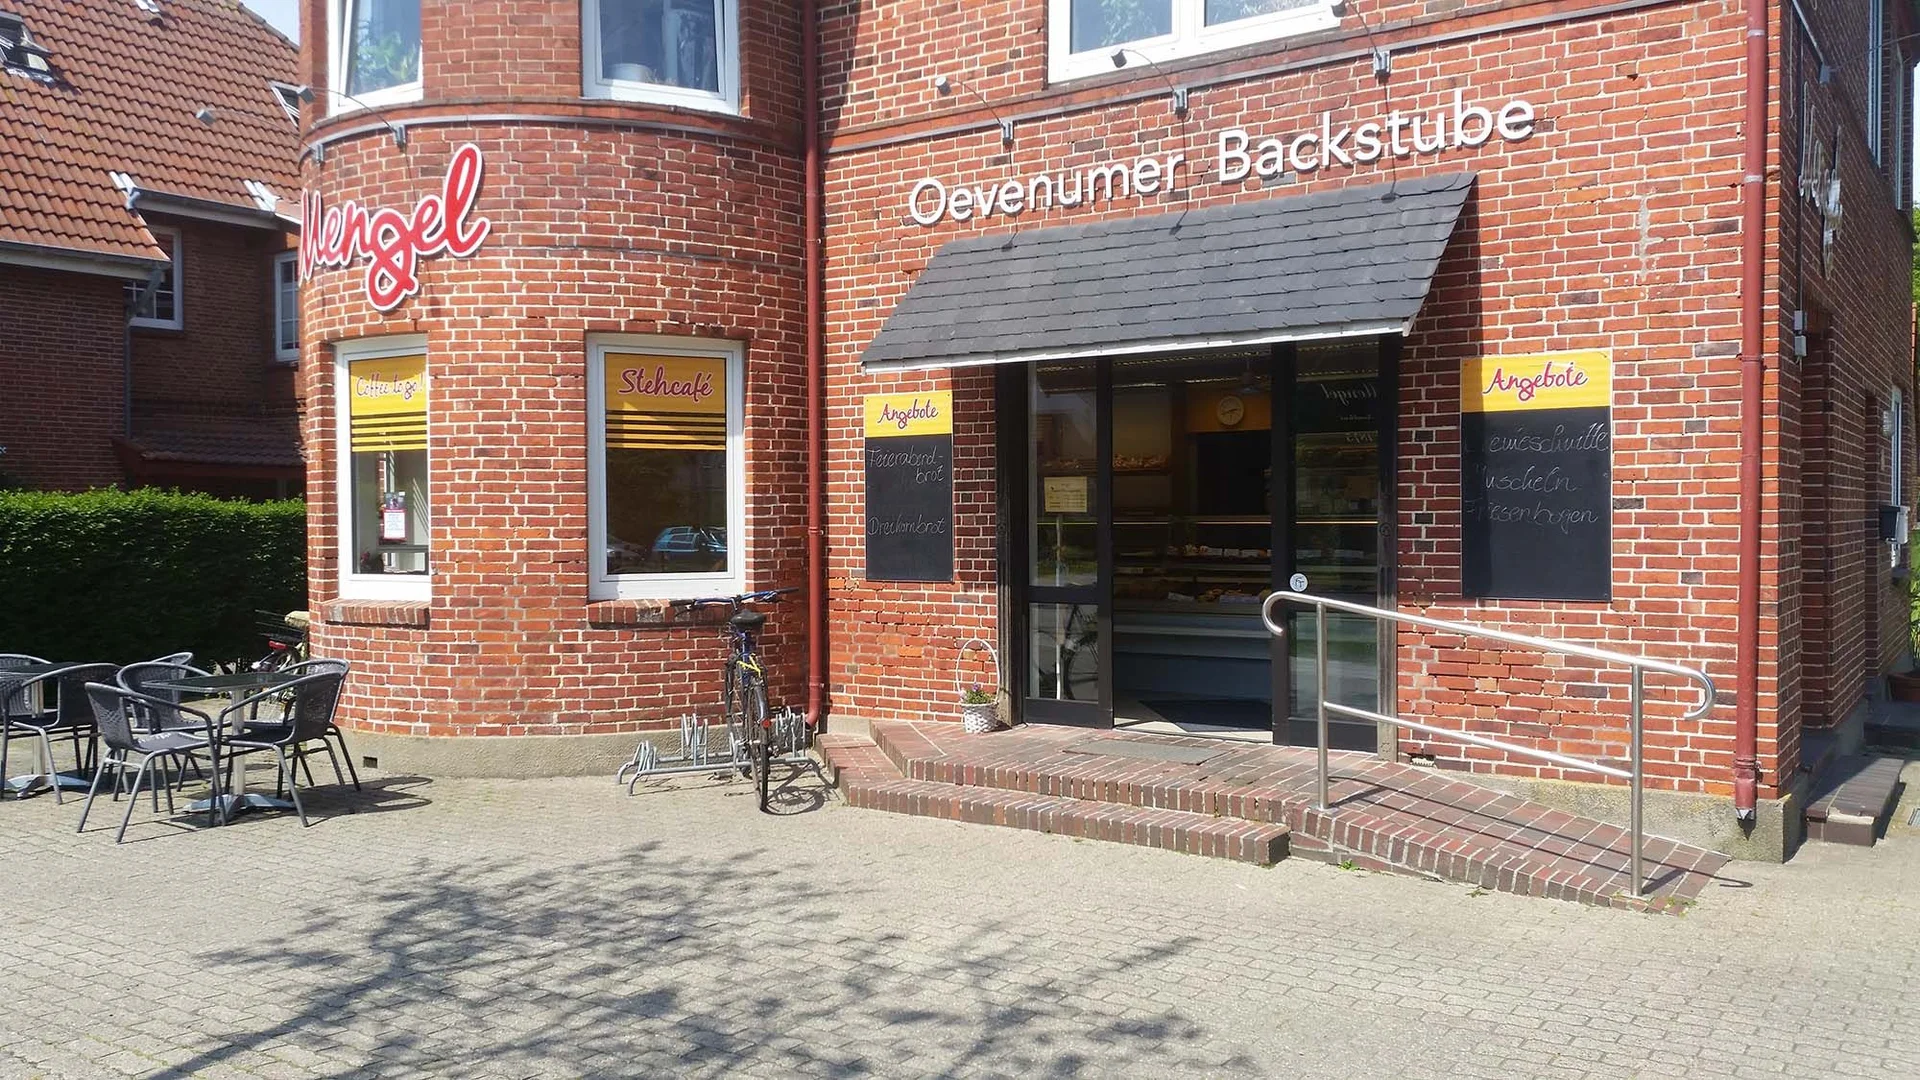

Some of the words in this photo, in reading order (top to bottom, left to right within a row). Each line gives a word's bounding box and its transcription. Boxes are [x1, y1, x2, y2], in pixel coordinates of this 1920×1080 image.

[908, 150, 1183, 226] Oevenumer
[1218, 89, 1535, 183] Backstube
[299, 142, 491, 311] Mengel
[356, 372, 389, 397] Coffee
[618, 365, 713, 402] Stehcafé
[1483, 362, 1587, 401] Angebote
[877, 398, 939, 429] Angebote
[915, 465, 945, 484] brot
[868, 513, 945, 535] Dreikornbrot
